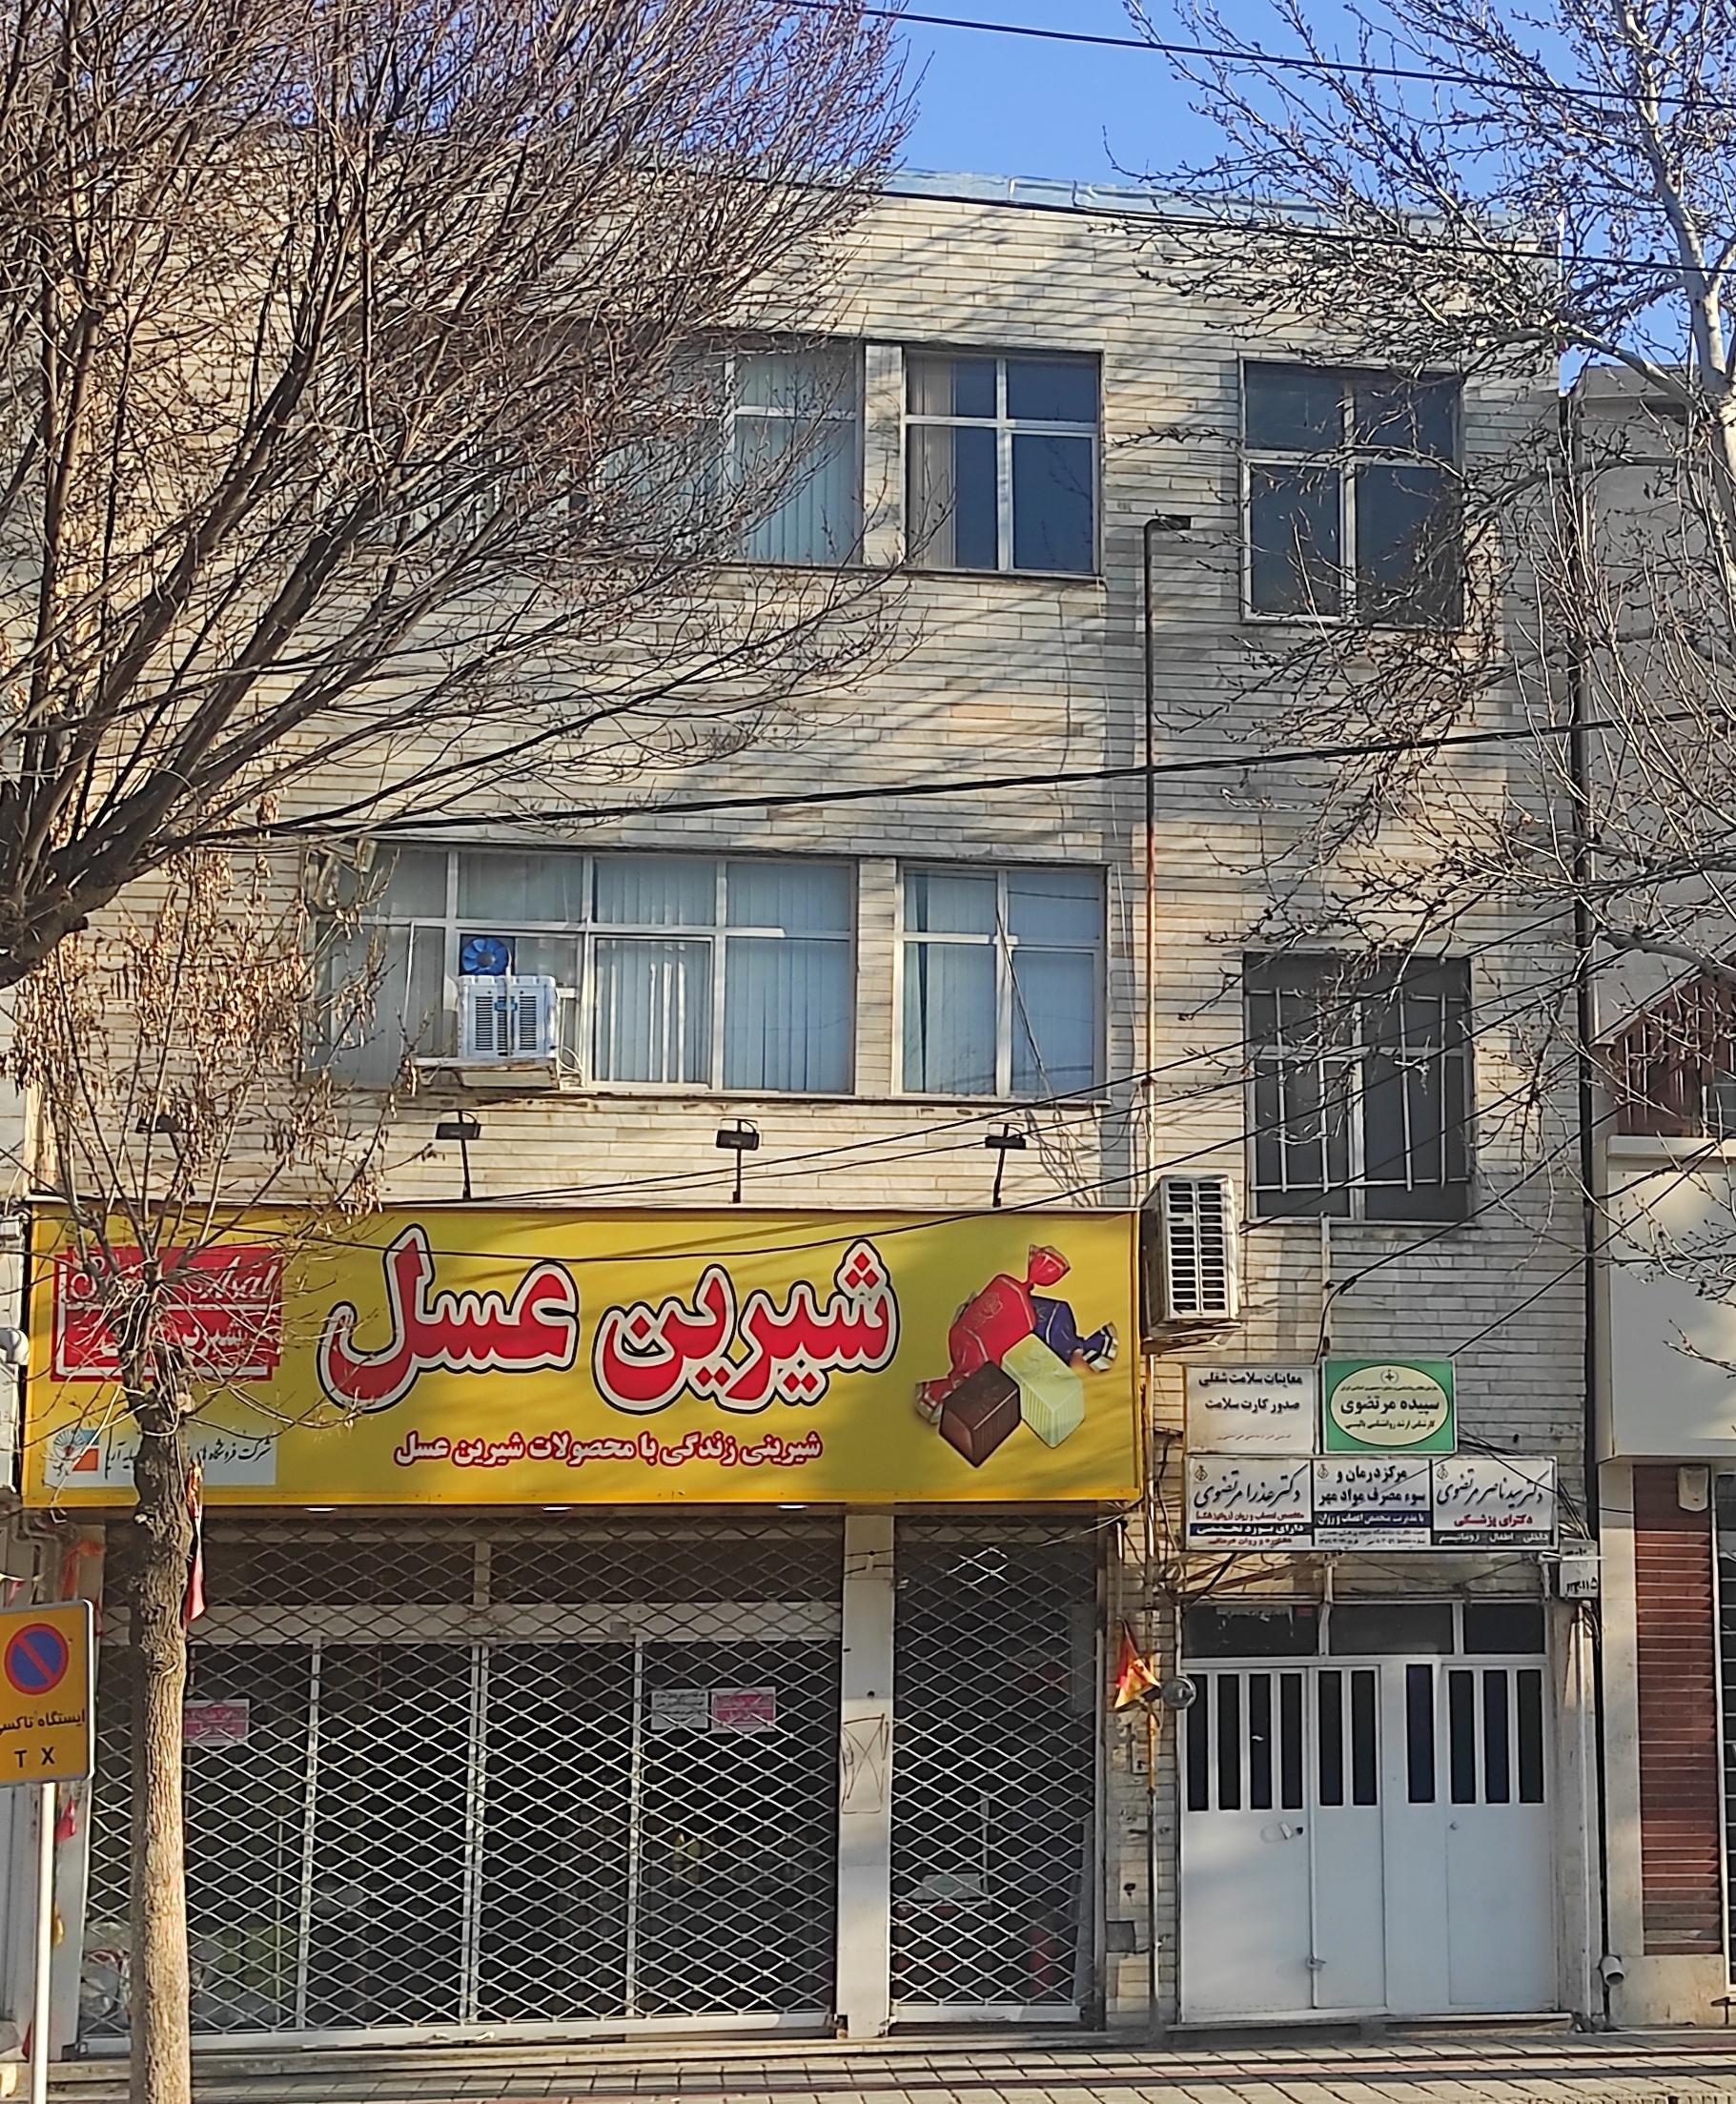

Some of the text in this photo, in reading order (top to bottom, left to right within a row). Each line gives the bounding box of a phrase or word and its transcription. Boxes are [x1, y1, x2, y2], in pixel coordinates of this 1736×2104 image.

[317, 1225, 899, 1414] شیرین عسل
[1198, 1372, 1303, 1388] معاینات سلامت شغلی
[1205, 1397, 1300, 1414] صدور کارت سلامت
[1340, 1396, 1440, 1415] سپیده مرتضوی
[394, 1430, 823, 1467] شیرینی زندگی با محصولات شیرین عسل
[1336, 1465, 1407, 1483] مرکز درمان و
[1194, 1463, 1308, 1508] دکتر عذرا مرتضوی
[1436, 1468, 1479, 1505] مرتضوی
[1517, 1470, 1549, 1507] دکتر
[1318, 1487, 1426, 1506] سوء مصرف مواد مهر
[1244, 1525, 1274, 1535] بورد
[1276, 1524, 1304, 1534] دارای
[1454, 1514, 1533, 1527] دکترای پزشکی
[1489, 1533, 1514, 1542] اطفال
[1522, 1533, 1549, 1543] داخلی
[38, 1708, 86, 1727] ایستگاه
[13, 1746, 55, 1768] T X
